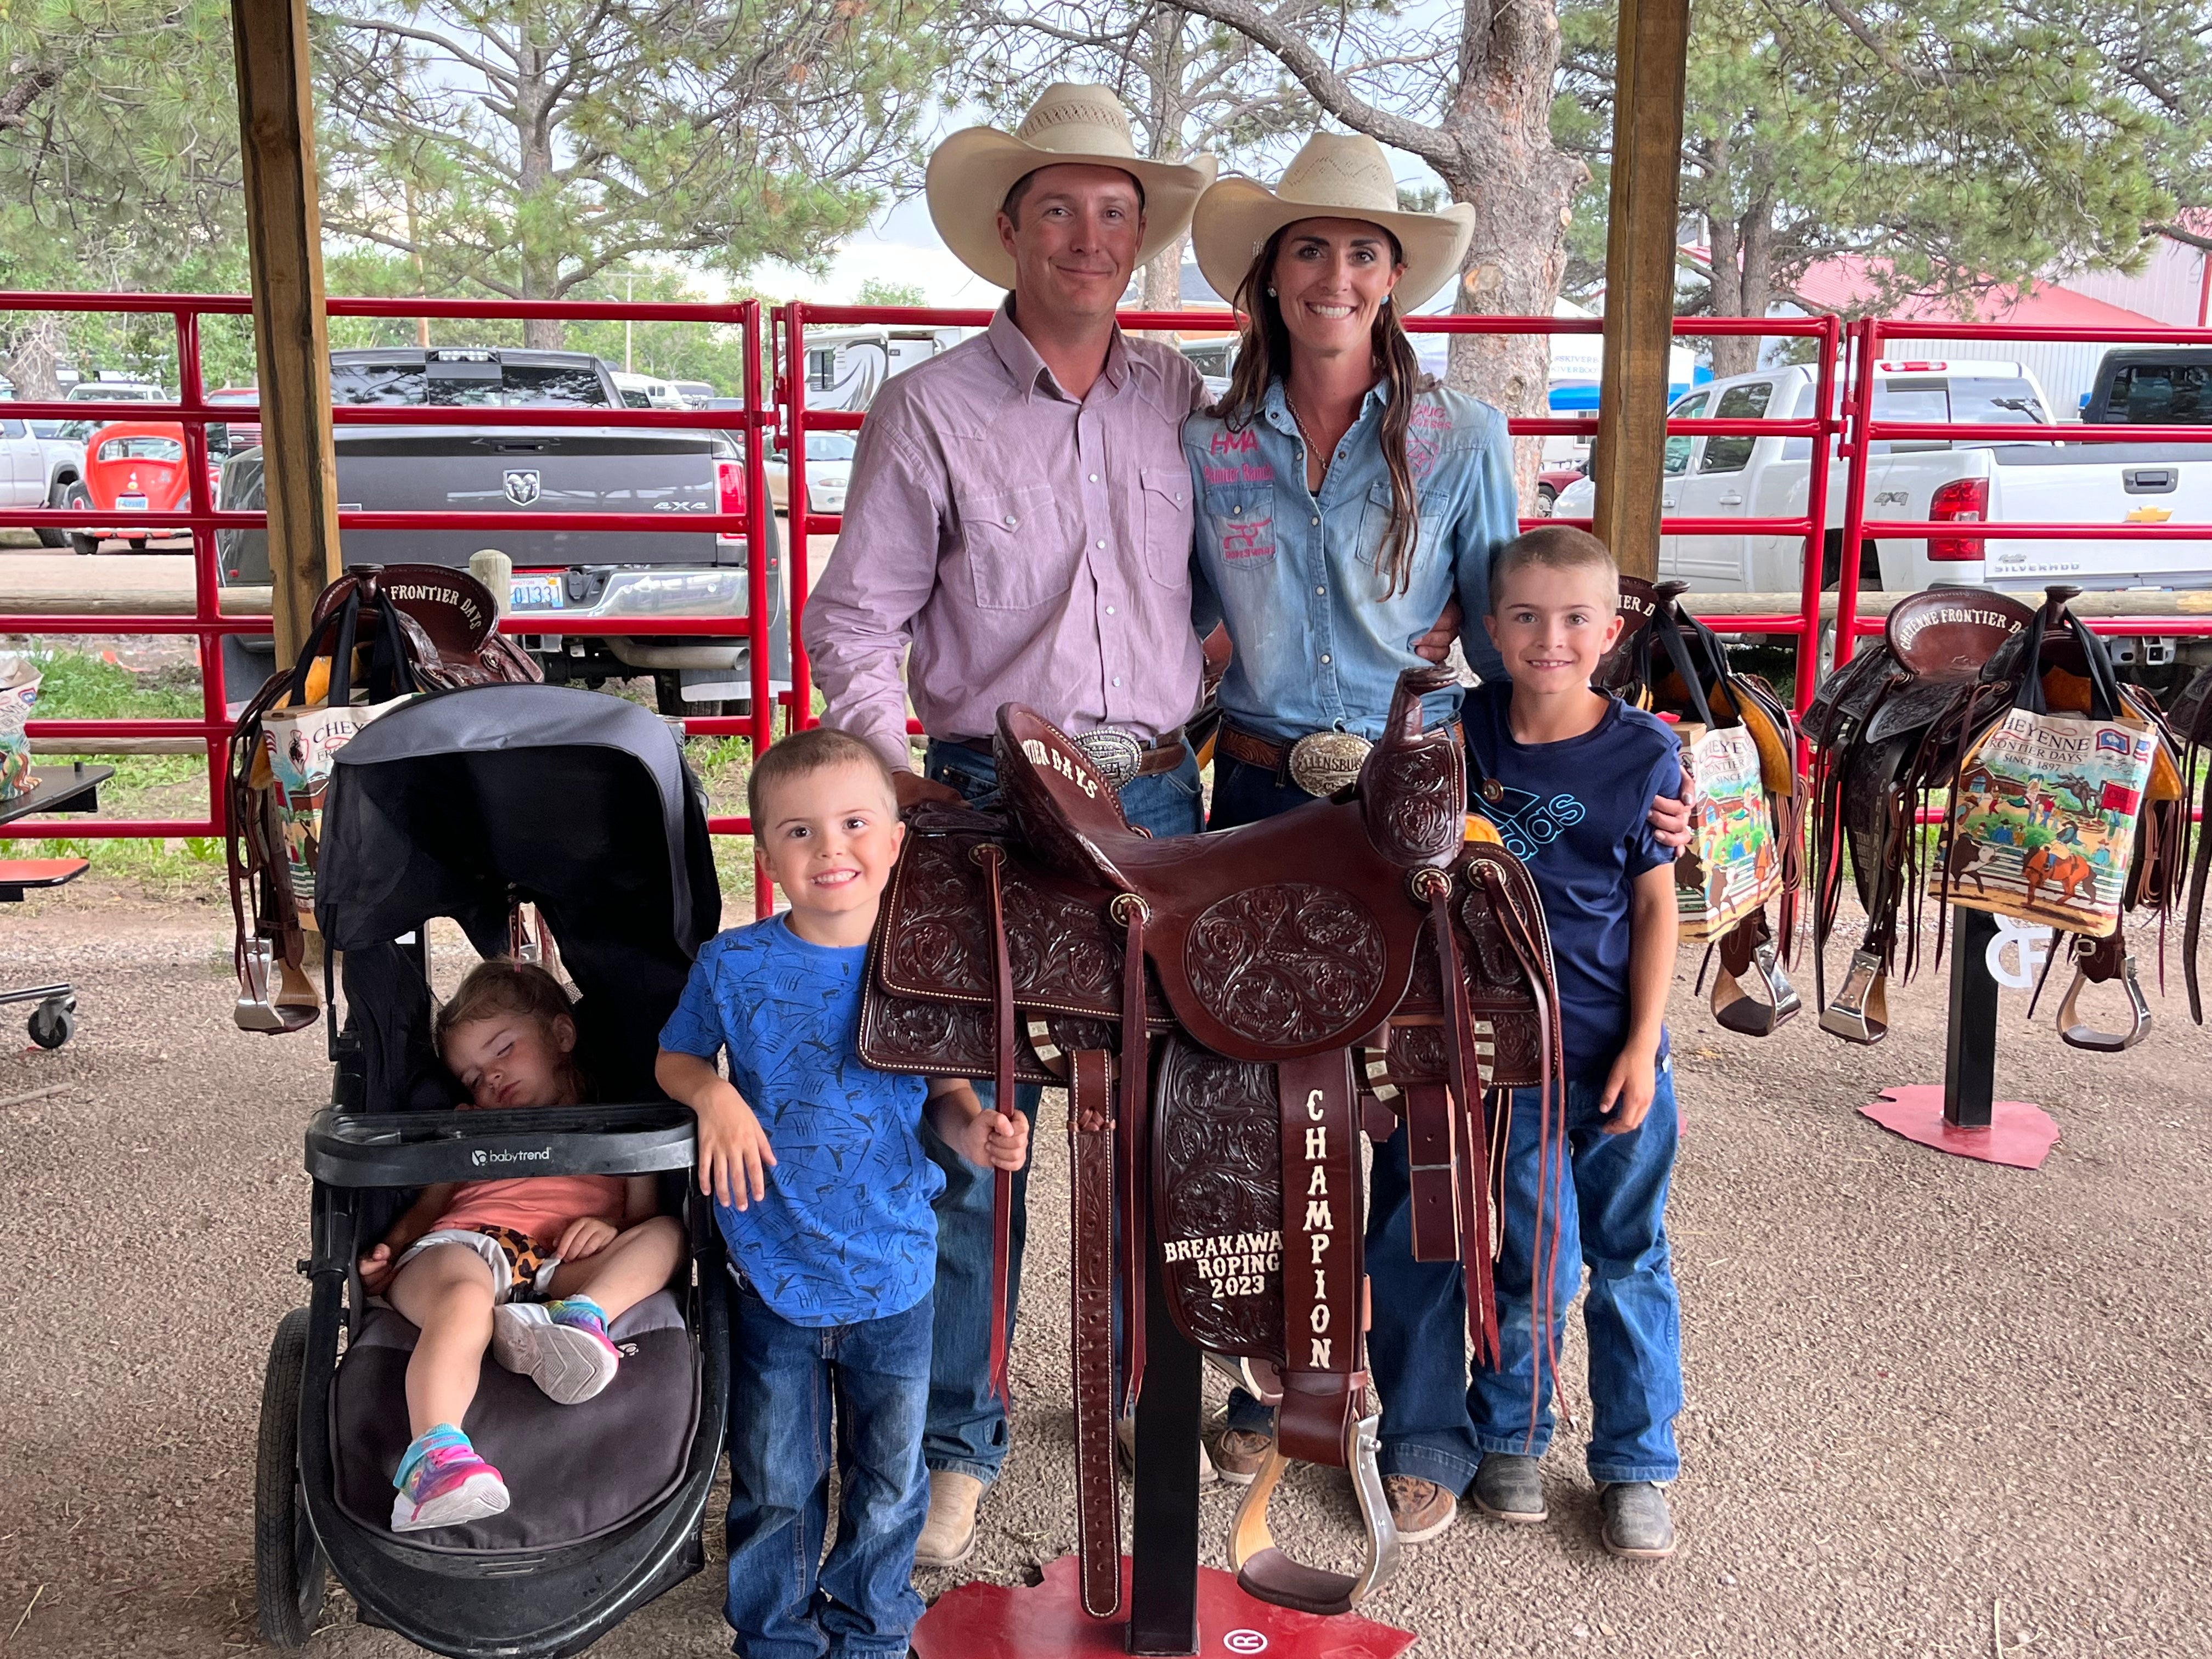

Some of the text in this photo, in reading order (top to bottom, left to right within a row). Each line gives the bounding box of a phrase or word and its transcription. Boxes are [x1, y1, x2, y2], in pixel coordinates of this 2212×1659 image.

[1995, 561, 2080, 572] SILVERADO
[391, 584, 482, 630] FRONTIER DAYS
[1900, 611, 1940, 651] CHEYENNE
[1940, 608, 2007, 629] FRONTIER
[2002, 717, 2090, 751] HEYENNE
[1989, 739, 2083, 763] RONTIER DAYS
[2003, 753, 2061, 772] SINCE 1897
[1051, 747, 1098, 799] DAYS
[489, 1147, 550, 1163] babytrend
[1303, 1088, 1334, 1369] CHAMPION
[1164, 1230, 1283, 1263] BREAKAWA
[1197, 1252, 1280, 1279] ROPING
[1210, 1274, 1265, 1299] 2023
